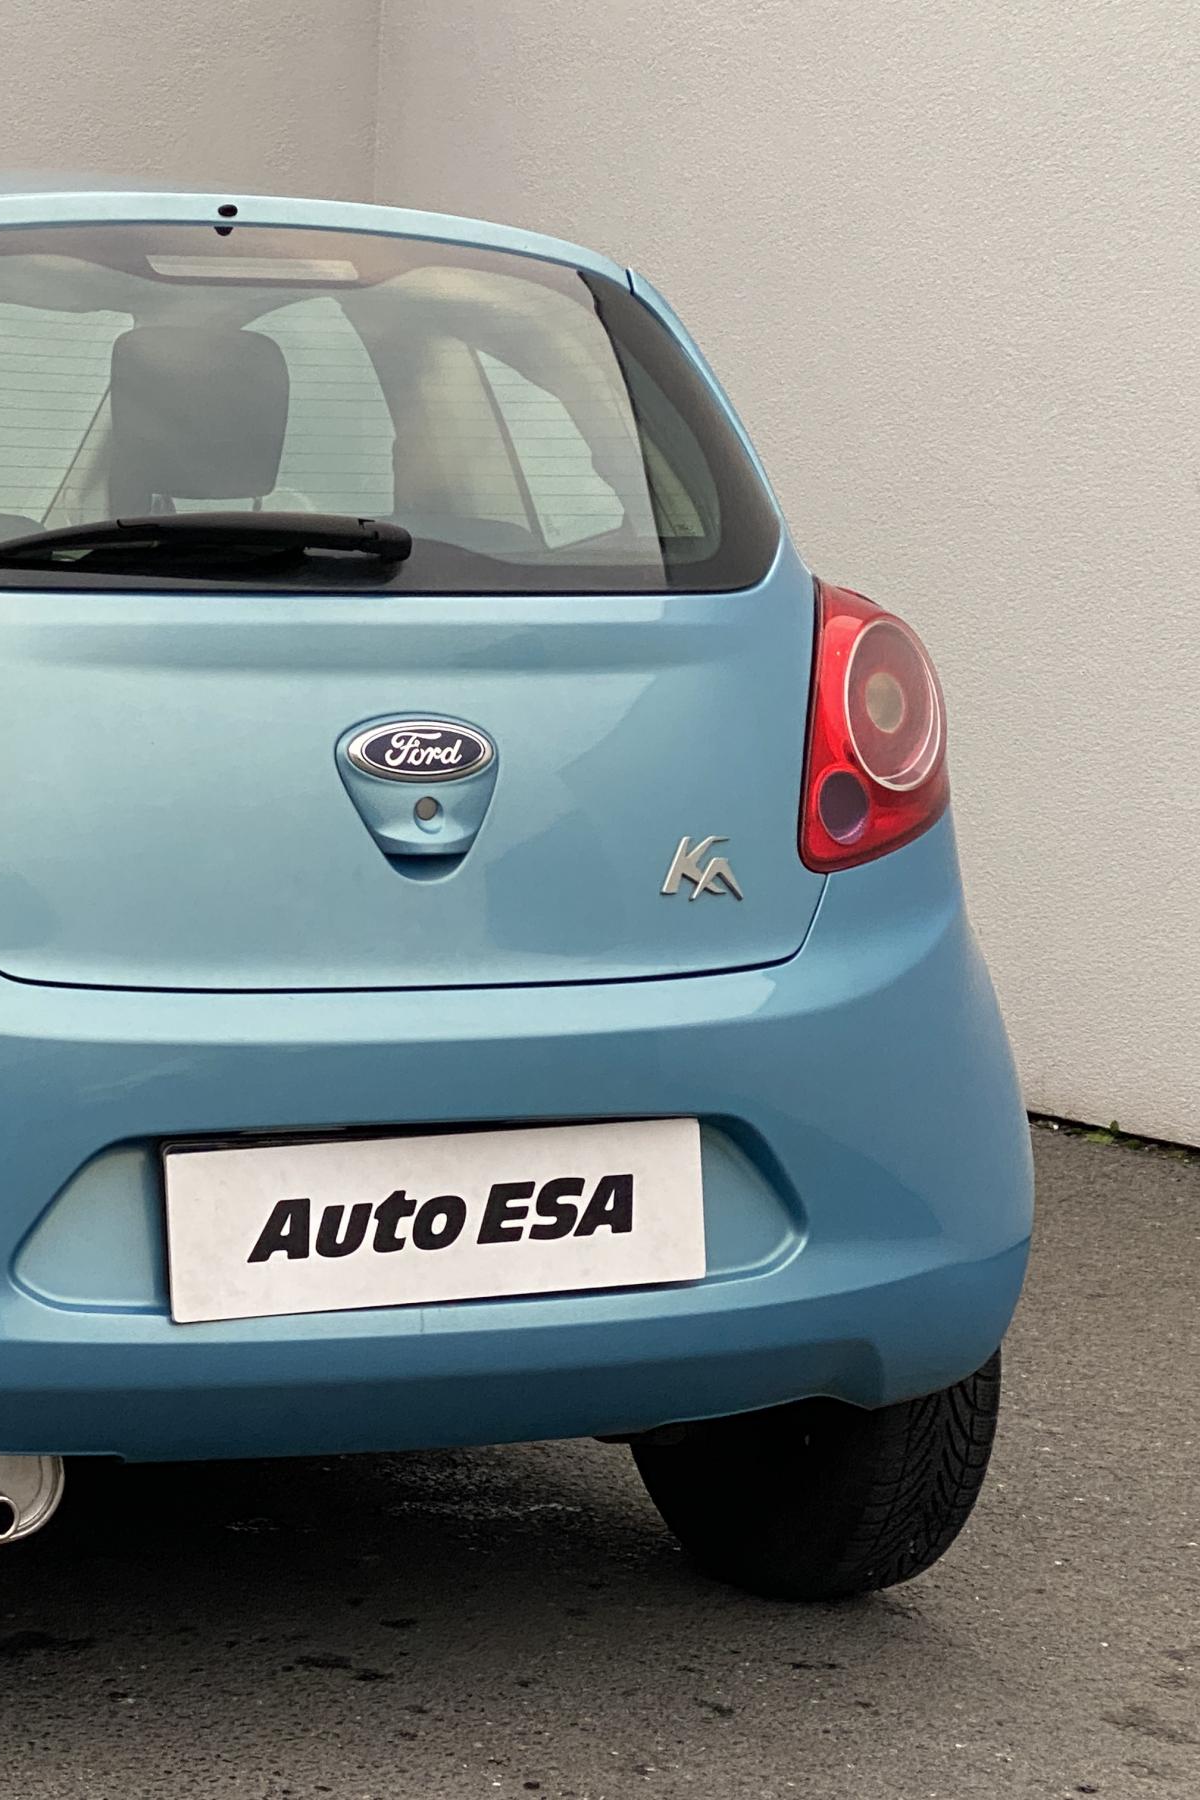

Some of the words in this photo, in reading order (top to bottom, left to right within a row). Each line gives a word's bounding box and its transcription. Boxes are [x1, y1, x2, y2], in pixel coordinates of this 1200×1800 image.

[385, 732, 462, 766] Ford
[247, 1190, 467, 1263] Auto
[476, 1173, 634, 1245] ESA
